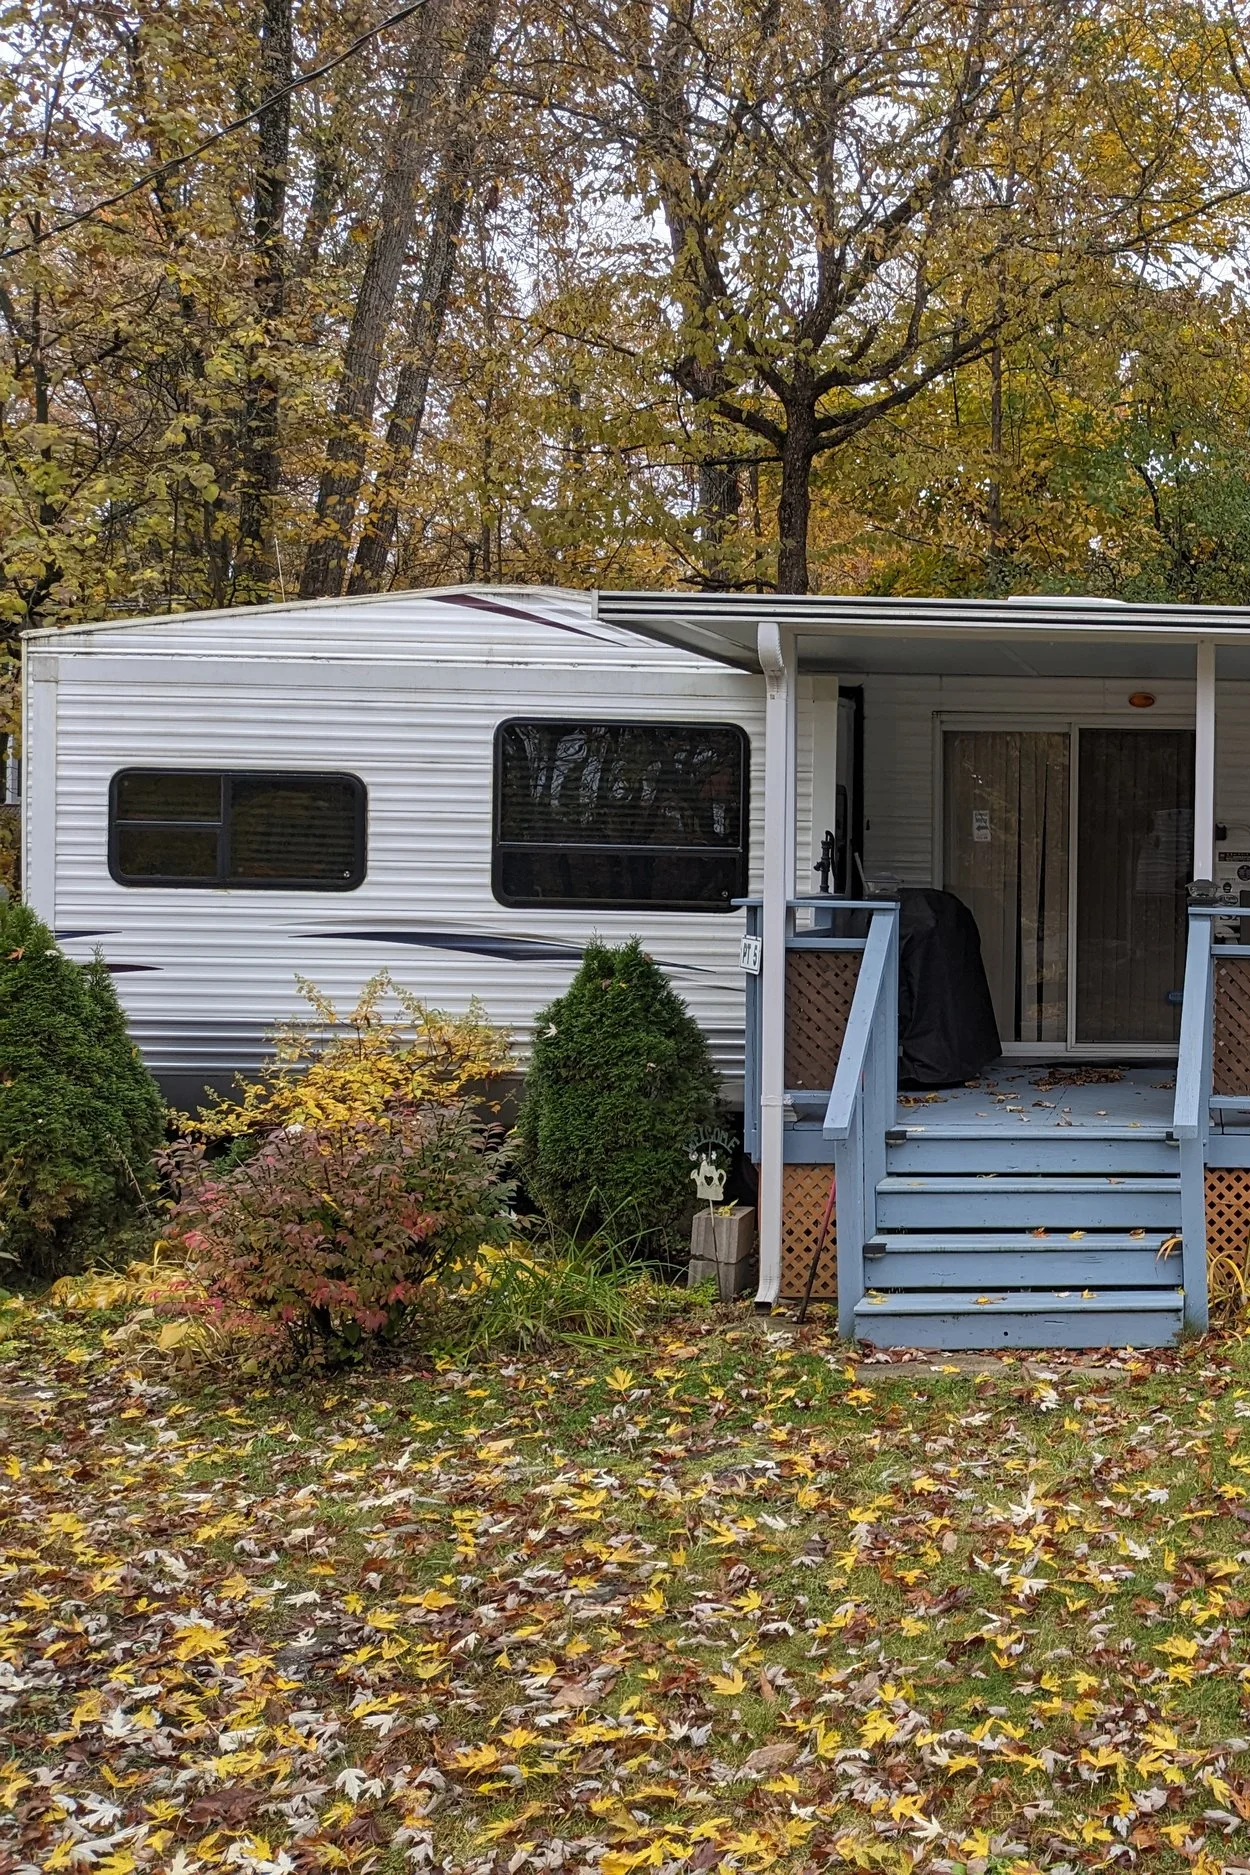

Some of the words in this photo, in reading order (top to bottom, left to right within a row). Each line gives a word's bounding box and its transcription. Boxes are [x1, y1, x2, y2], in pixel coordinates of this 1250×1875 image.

[742, 942, 751, 965] PT
[752, 944, 758, 967] 5
[681, 1126, 741, 1152] WELCOME
